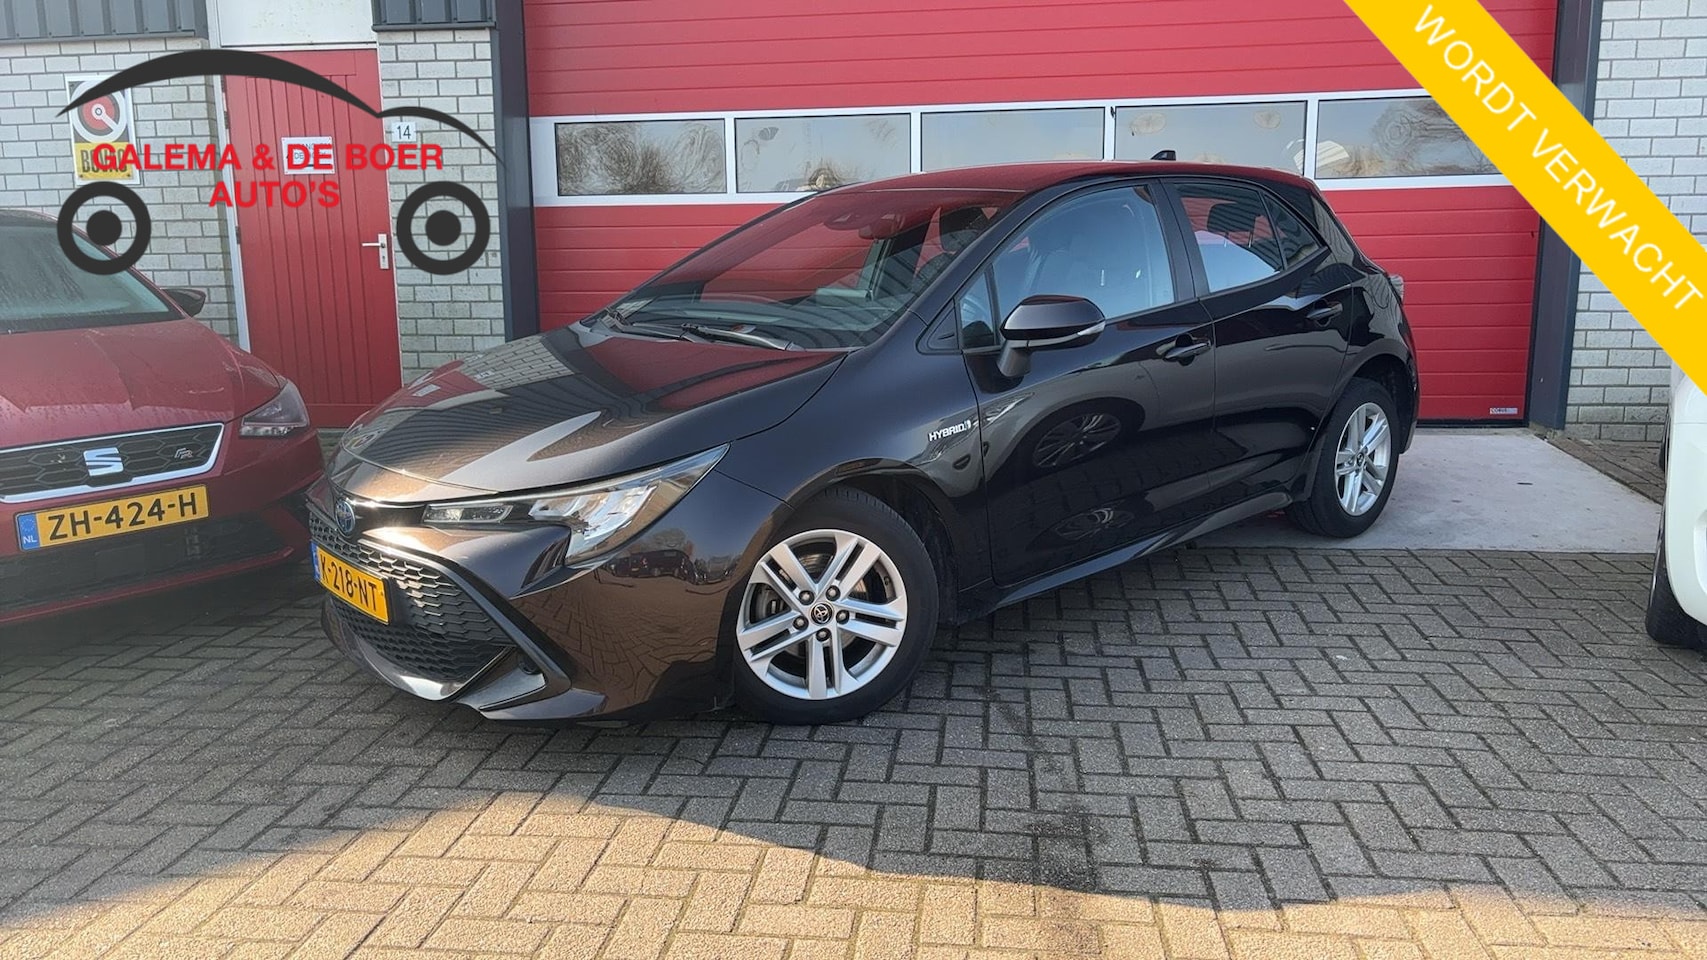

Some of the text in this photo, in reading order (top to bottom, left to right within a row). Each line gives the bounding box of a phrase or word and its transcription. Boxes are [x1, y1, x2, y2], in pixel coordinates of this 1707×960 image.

[396, 124, 411, 140] 14
[928, 423, 967, 442] HYBRID
[47, 492, 198, 541] ZH-424-H
[23, 534, 38, 545] NL
[320, 553, 378, 612] K-218-NT
